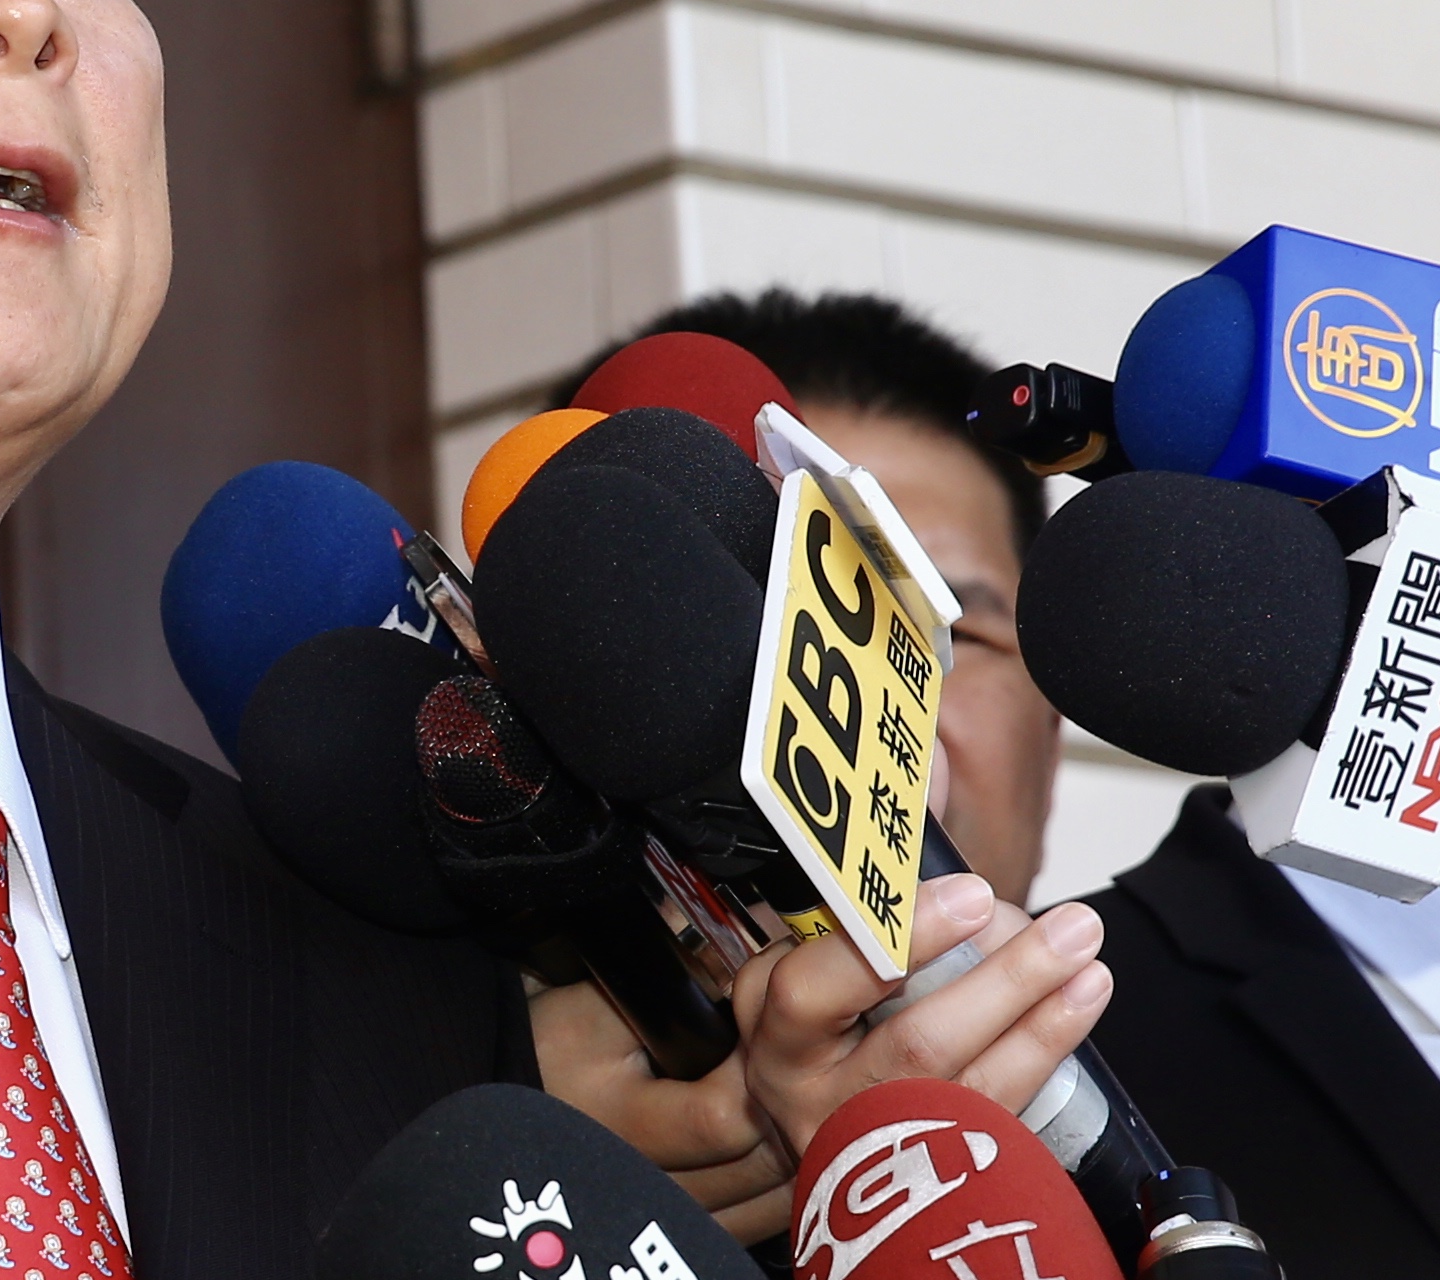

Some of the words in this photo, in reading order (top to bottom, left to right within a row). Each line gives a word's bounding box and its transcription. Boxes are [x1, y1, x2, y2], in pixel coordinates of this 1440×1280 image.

[773, 509, 876, 871] EBC
[858, 610, 933, 949] 東森新聞
